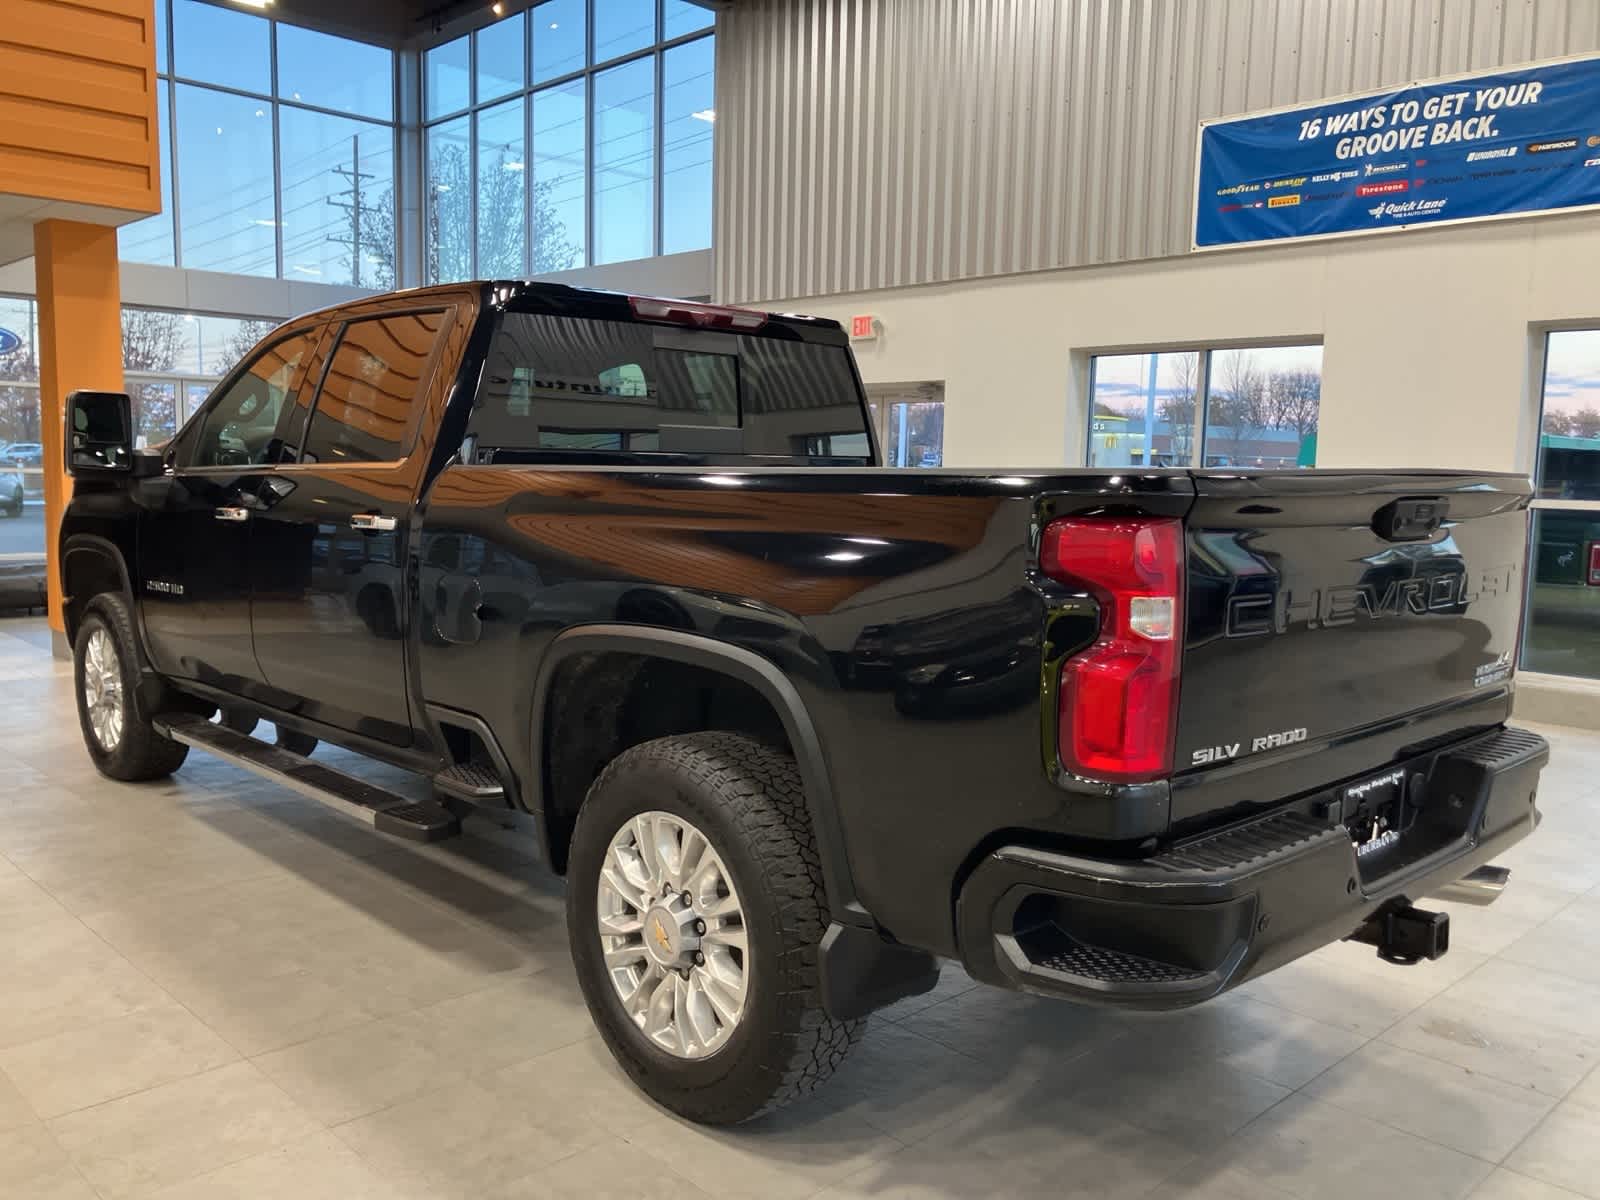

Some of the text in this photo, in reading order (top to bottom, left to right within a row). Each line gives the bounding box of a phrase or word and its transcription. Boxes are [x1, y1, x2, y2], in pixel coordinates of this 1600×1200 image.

[1298, 81, 1543, 141] 16 WAYS TO GET YOUR
[1335, 114, 1499, 160] GROOVE BACK.
[1361, 184, 1404, 195] Firestone
[1385, 199, 1447, 214] Quick Lane
[854, 318, 872, 335] EXIT
